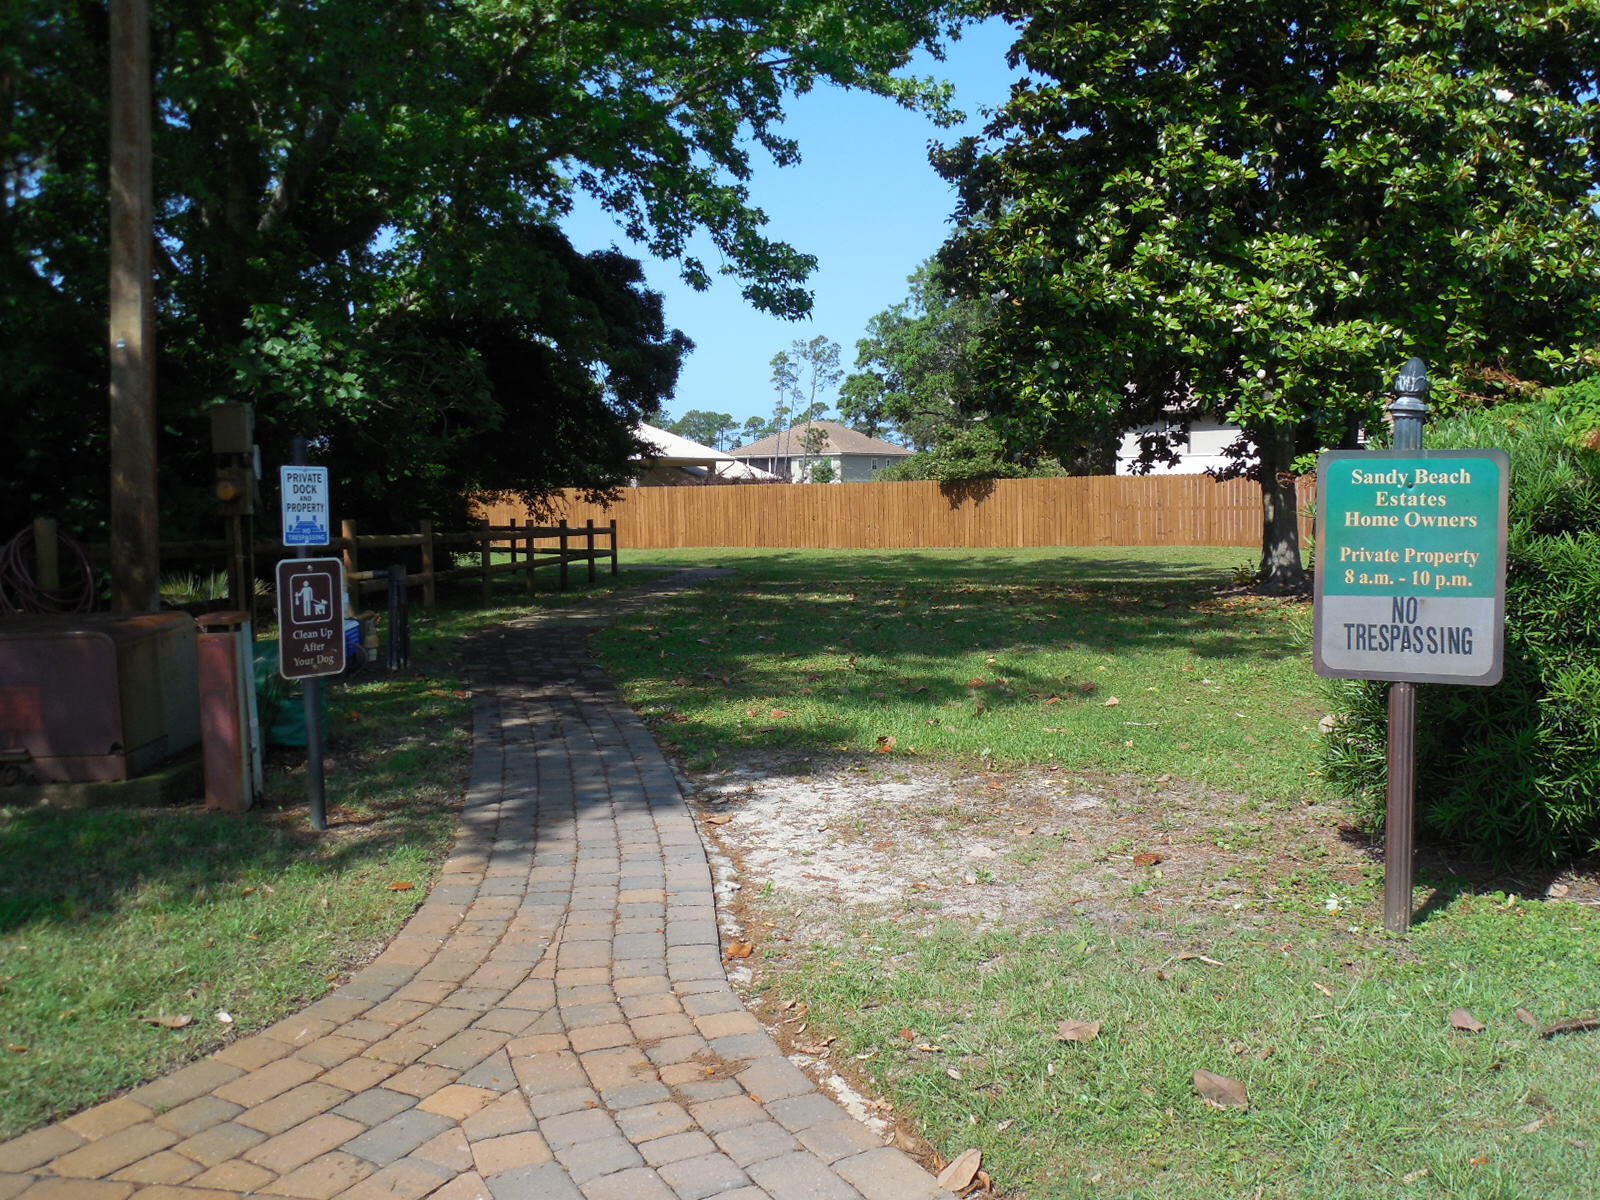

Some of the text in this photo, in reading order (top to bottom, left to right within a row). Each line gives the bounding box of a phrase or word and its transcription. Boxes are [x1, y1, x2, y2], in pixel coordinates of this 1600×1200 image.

[287, 473, 322, 483] PRIVATE
[1351, 469, 1471, 488] Sandy Beach
[293, 484, 317, 494] DOCK
[1375, 492, 1446, 507] Estates
[287, 503, 324, 513] PROPERTY
[1345, 511, 1477, 528] Home Owners
[1340, 547, 1479, 567] Private Property
[1345, 570, 1354, 584] 8
[1359, 572, 1394, 585] a.m.
[1412, 571, 1430, 586] 10
[1435, 573, 1472, 590] p.m.
[1392, 597, 1418, 624] NO
[293, 627, 333, 640] Clean Up
[1344, 623, 1472, 655] TRESPASSING
[303, 642, 325, 652] After
[294, 655, 334, 666] Your Dog
